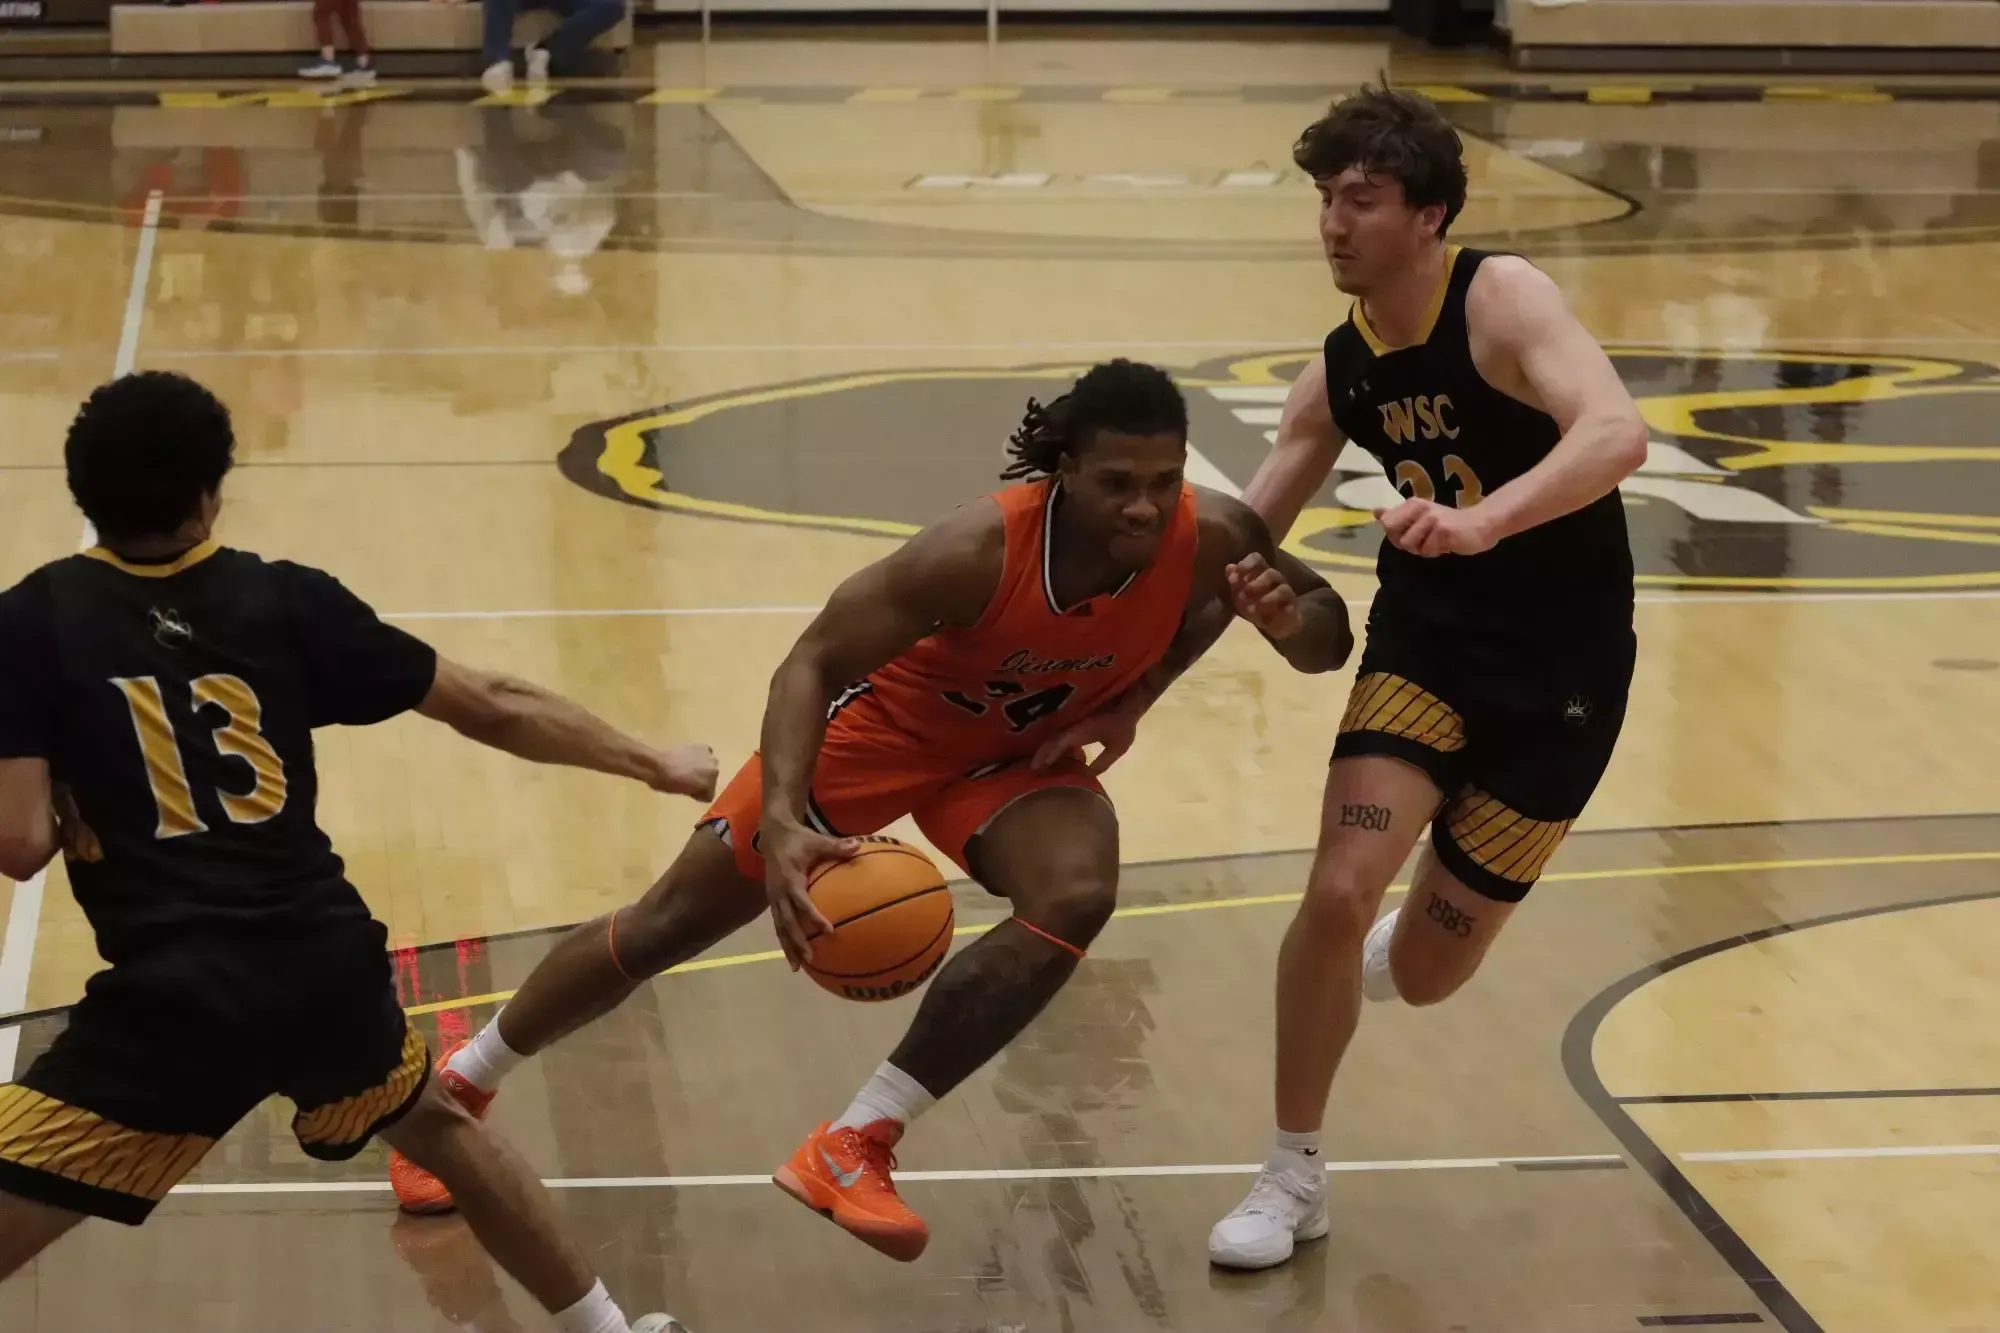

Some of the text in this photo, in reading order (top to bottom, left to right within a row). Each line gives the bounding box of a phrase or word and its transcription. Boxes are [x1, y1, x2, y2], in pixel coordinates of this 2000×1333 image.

[1377, 393, 1460, 445] WSC
[106, 673, 288, 840] 13
[1339, 804, 1393, 833] 1980
[1425, 893, 1478, 938] 1985
